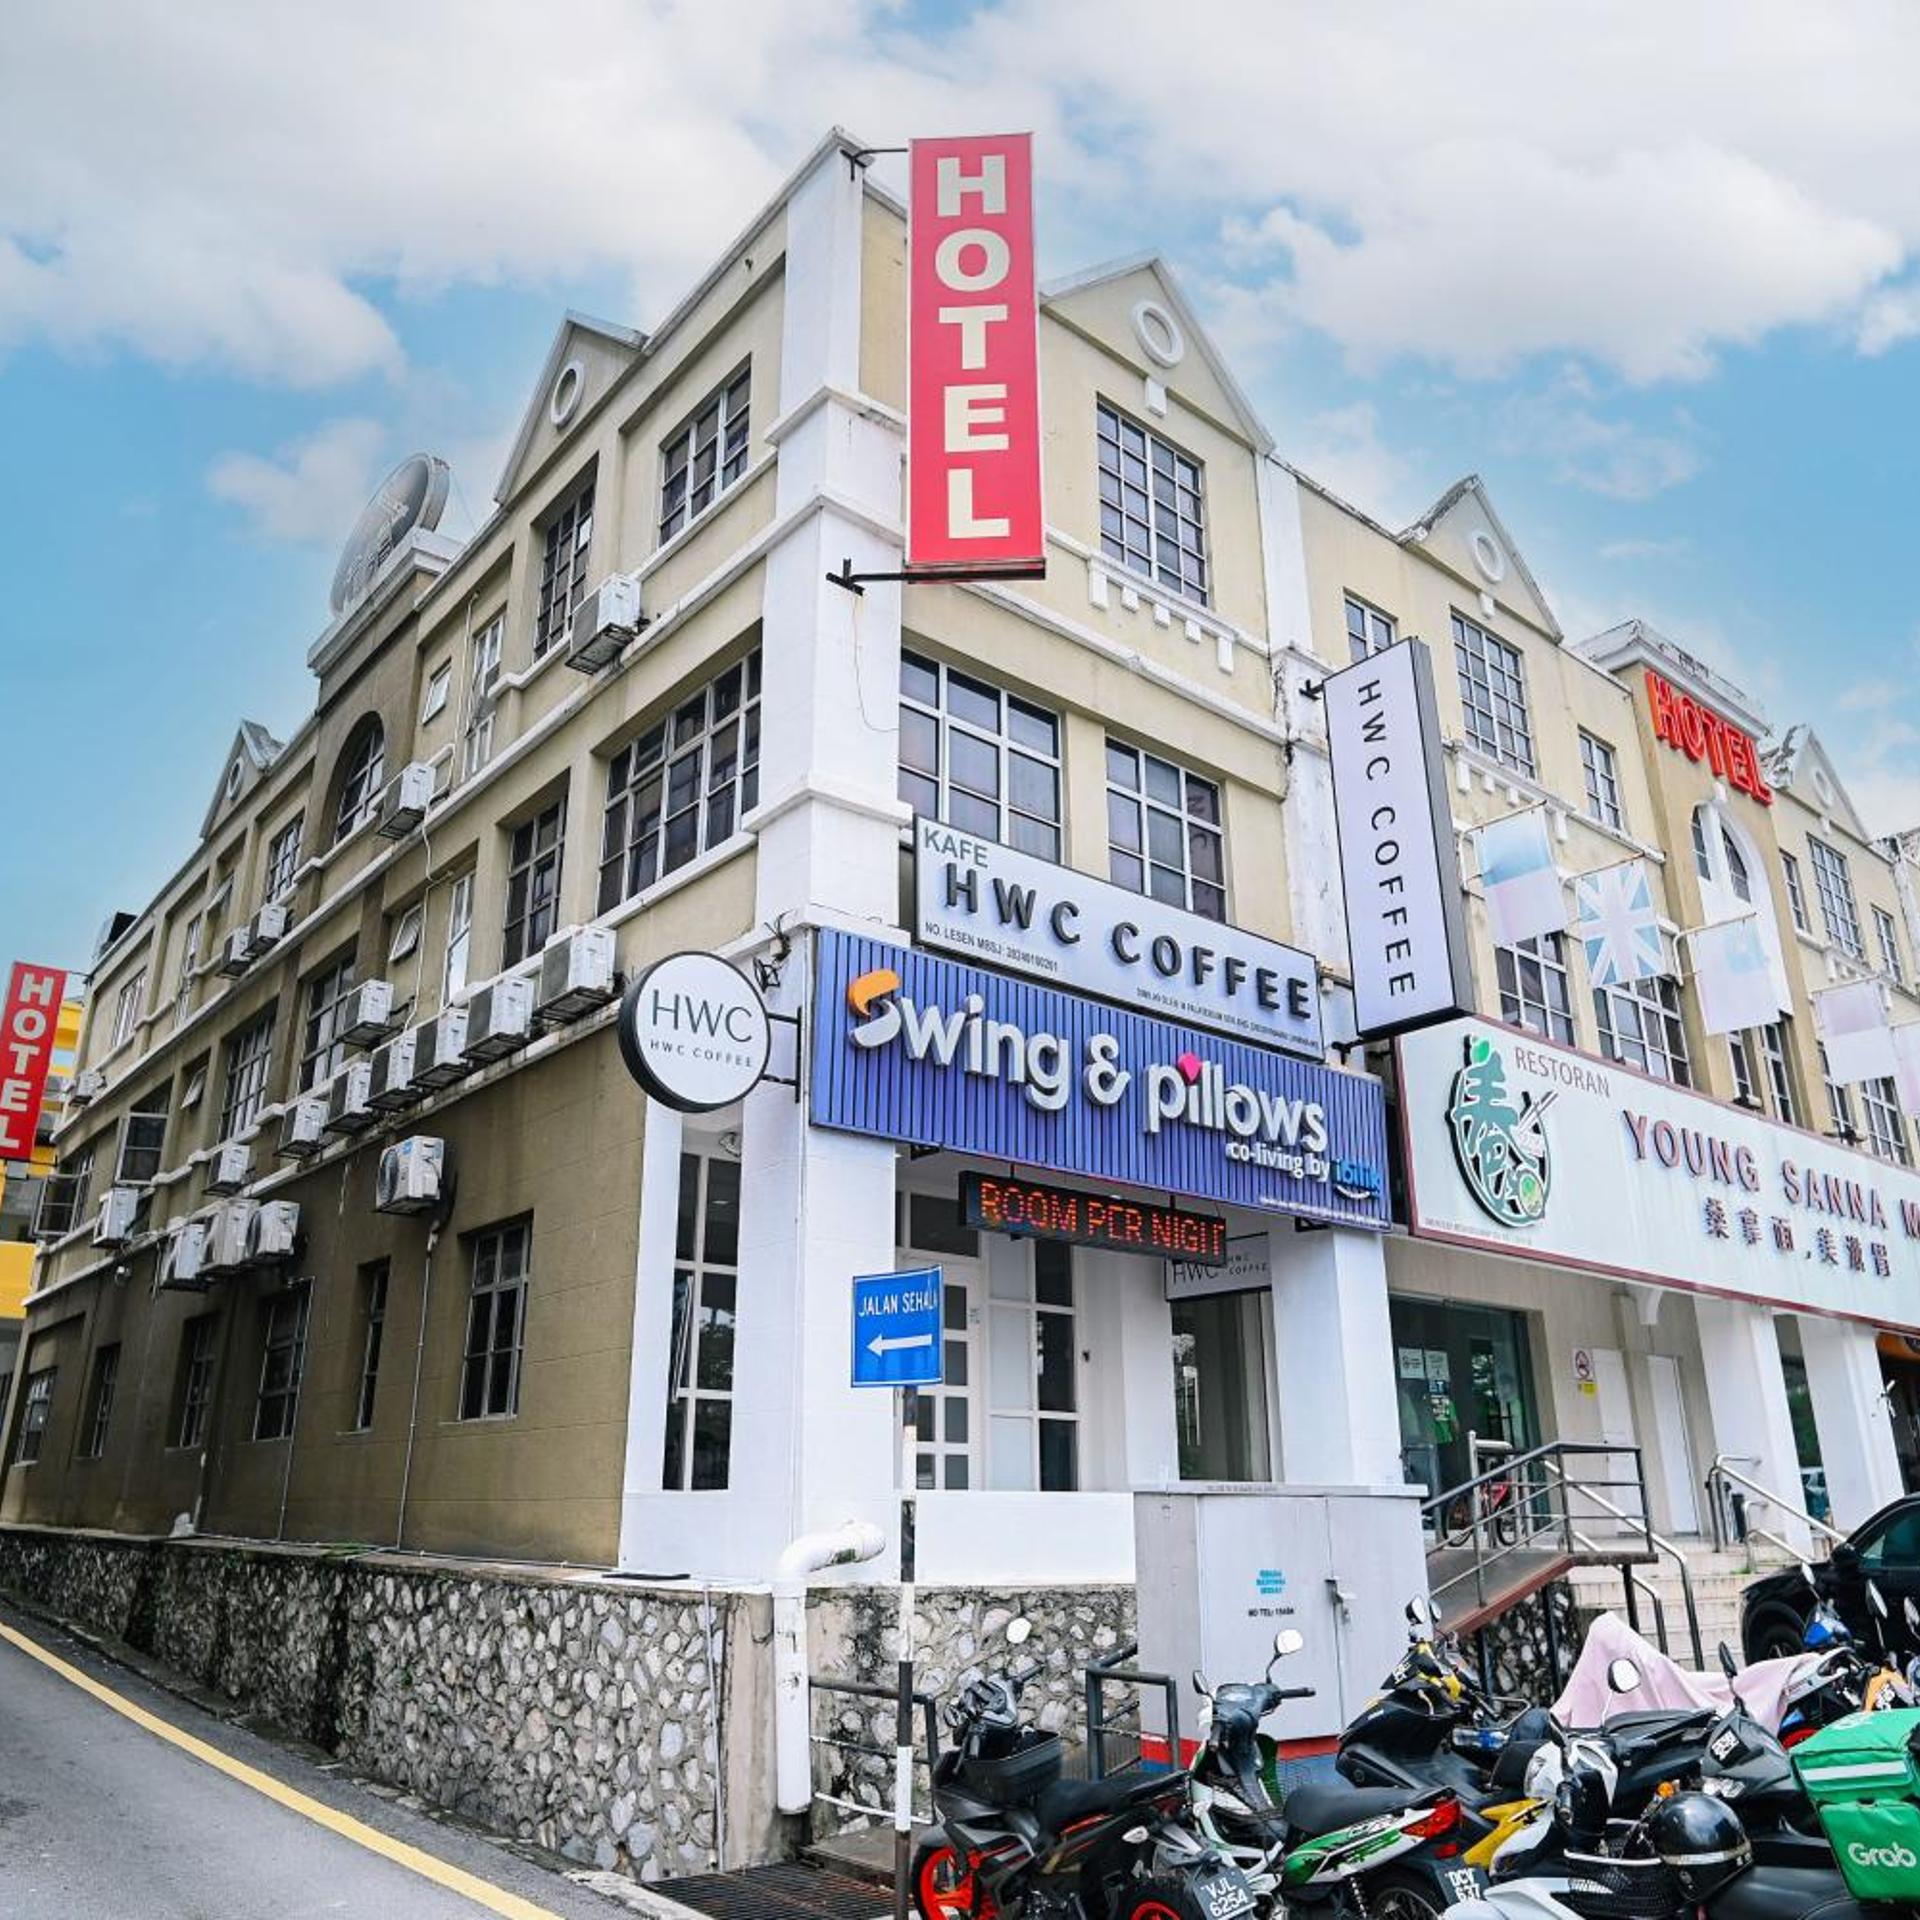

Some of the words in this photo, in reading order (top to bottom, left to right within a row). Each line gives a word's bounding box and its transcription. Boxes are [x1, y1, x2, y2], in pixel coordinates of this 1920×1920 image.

[935, 154, 1011, 539] HOTEL
[1357, 679, 1390, 781] HWC
[1644, 668, 1773, 808] HOTEL
[924, 828, 989, 868] KAFE
[1371, 806, 1416, 997] COFFEE
[944, 928, 975, 946] LESEN
[945, 862, 1080, 944] HWC
[1110, 921, 1312, 1020] COFFEE
[652, 989, 753, 1043] HWC
[0, 972, 54, 1149] HOTEL
[650, 1039, 685, 1055] HWC
[692, 1047, 752, 1068] COFFEE
[847, 967, 1069, 1112] Swing
[1084, 1033, 1131, 1105] &
[1144, 1052, 1327, 1153] pillows
[1515, 1047, 1610, 1098] RESTORAN
[1225, 1142, 1304, 1179] co-living
[1305, 1153, 1330, 1182] by
[1623, 1109, 1760, 1192] YOUNG
[1782, 1159, 1887, 1230] SANNA
[981, 1182, 1077, 1233] ROOM
[1229, 1262, 1267, 1275] COFFEE
[858, 1293, 898, 1317] JALAN
[1848, 1841, 1917, 1868] Grab
[1205, 1877, 1238, 1899] VJL
